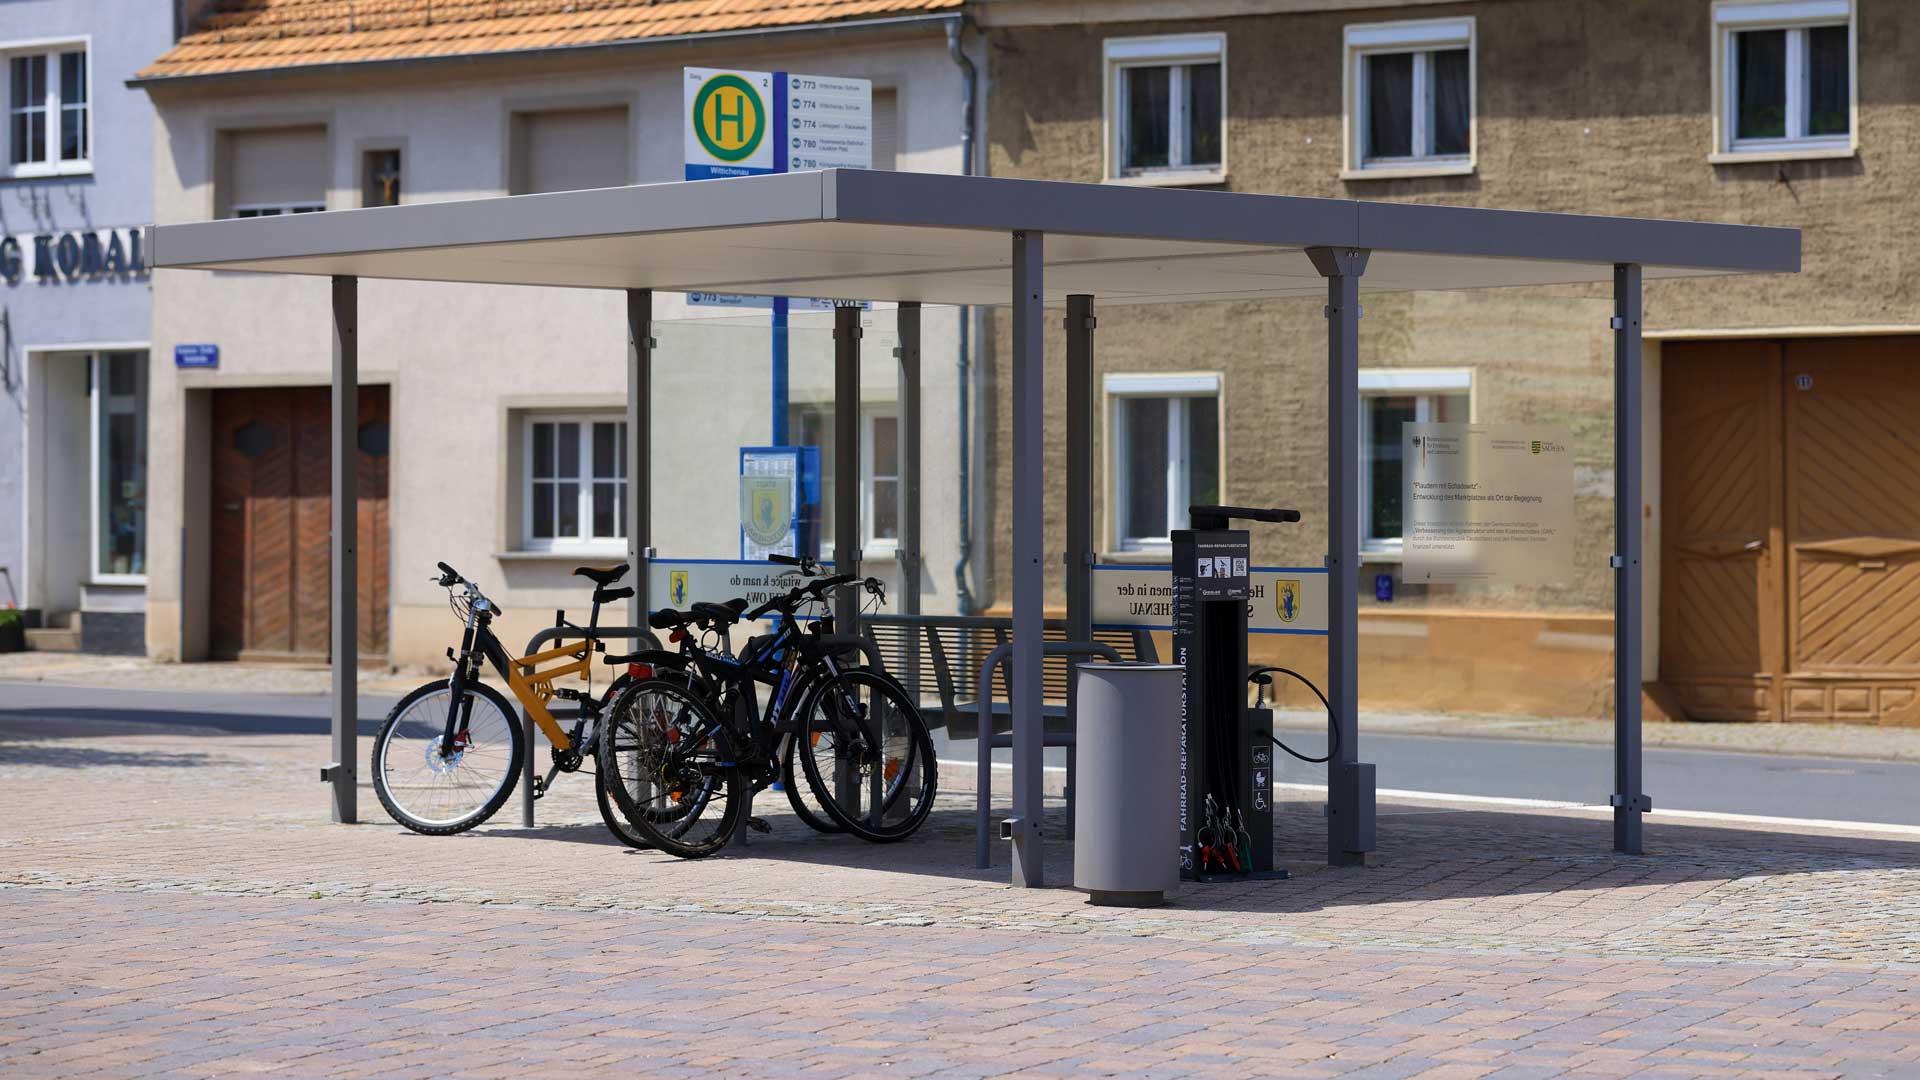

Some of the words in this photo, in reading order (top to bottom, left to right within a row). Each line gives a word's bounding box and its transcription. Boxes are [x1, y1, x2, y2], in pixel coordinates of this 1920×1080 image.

[762, 78, 769, 87] 2
[802, 80, 816, 89] 773
[802, 100, 816, 109] 774
[715, 93, 744, 143] H
[802, 120, 816, 129] 774
[802, 140, 816, 148] 780
[802, 160, 816, 168] 780
[710, 166, 750, 176] Wittichenau
